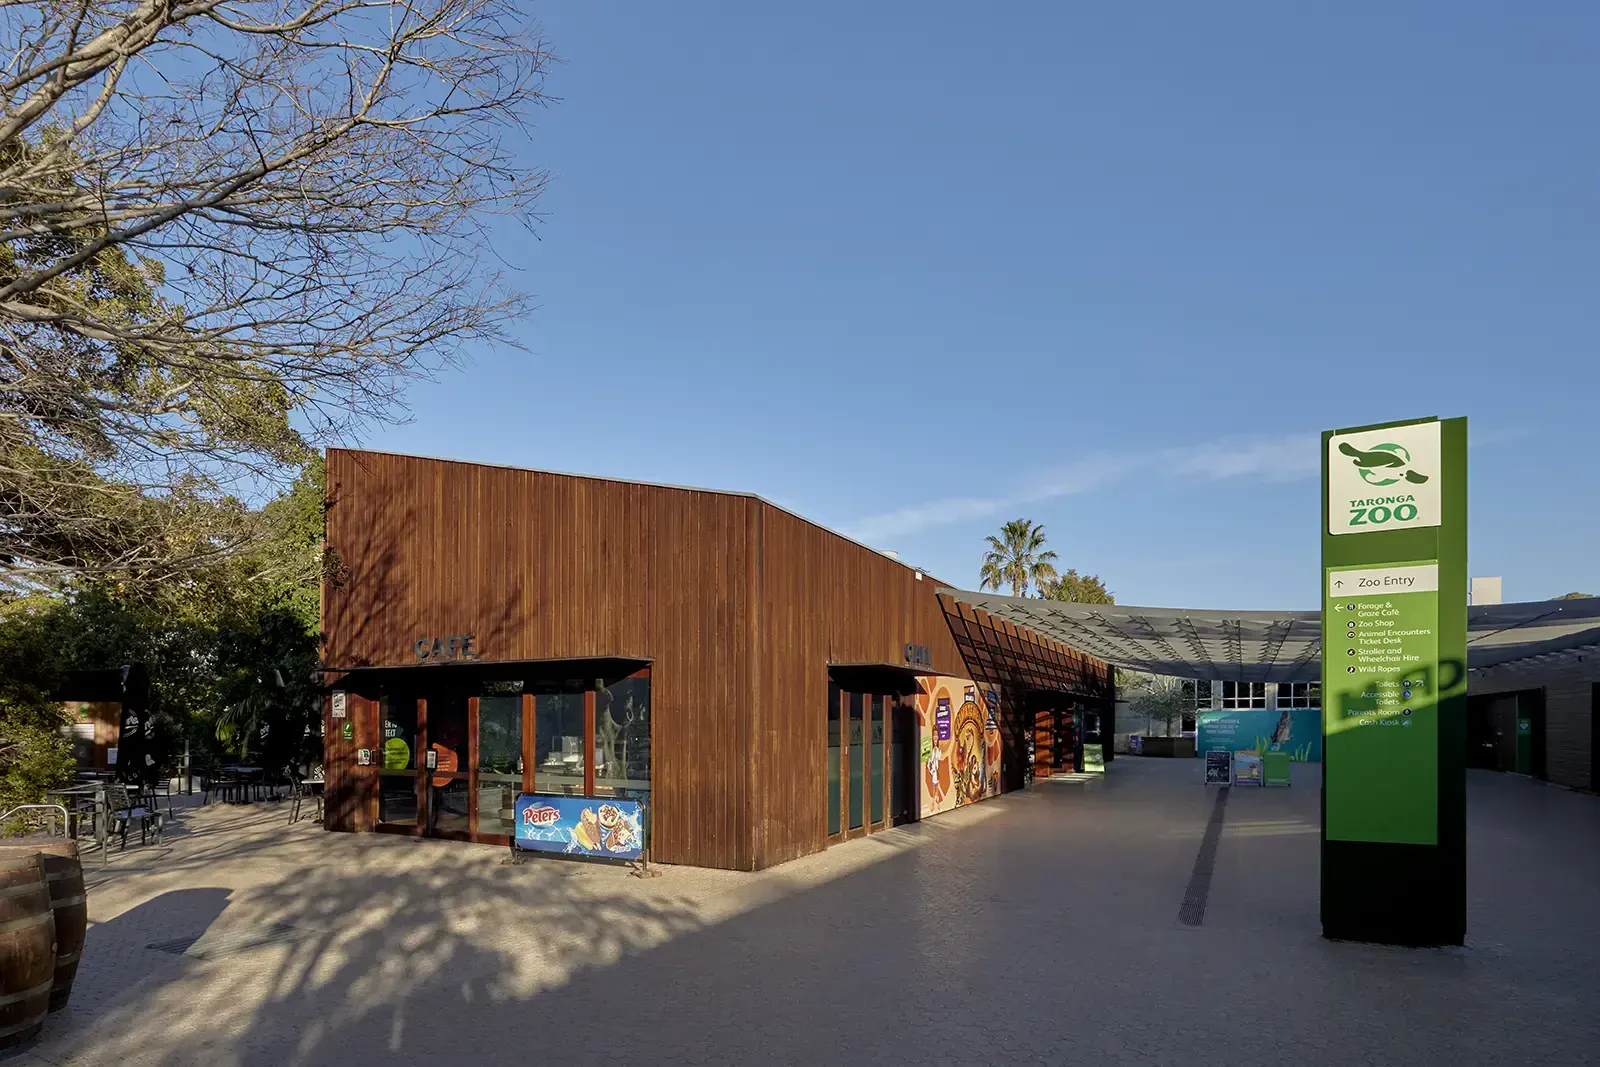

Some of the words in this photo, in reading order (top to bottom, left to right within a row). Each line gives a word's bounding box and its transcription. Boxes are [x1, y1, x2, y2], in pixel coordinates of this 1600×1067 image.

[1350, 495, 1415, 507] TARONGA
[1349, 504, 1418, 526] ZOO
[1358, 578, 1381, 588] Zoo
[1384, 576, 1416, 587] Entry
[1385, 601, 1392, 609] &
[414, 635, 476, 658] CAFE
